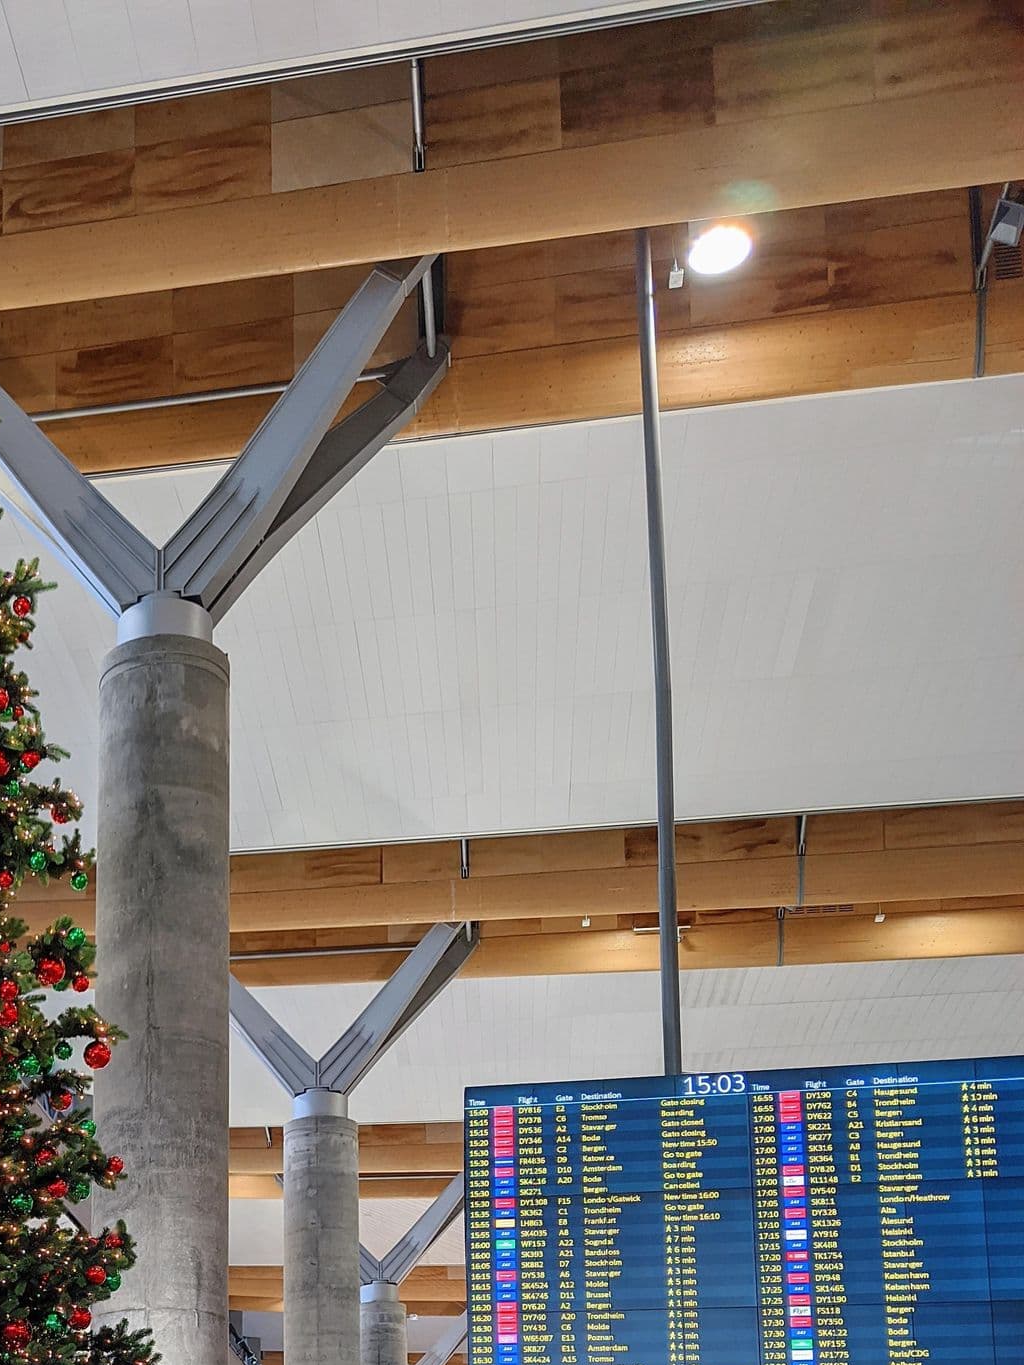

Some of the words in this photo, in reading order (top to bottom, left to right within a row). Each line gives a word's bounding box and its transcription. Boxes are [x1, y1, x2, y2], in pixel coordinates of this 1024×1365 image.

[684, 1074, 745, 1095] 15:03
[752, 1083, 770, 1091] Time
[805, 1080, 827, 1090] Flight
[873, 1075, 918, 1085] Destination
[469, 1099, 486, 1107] Time
[556, 1094, 573, 1102] Gate
[581, 1091, 622, 1101] Destination
[753, 1094, 774, 1102] 16:55
[874, 1087, 918, 1097] Haugesund
[875, 1097, 916, 1107] Trondheim
[469, 1108, 489, 1117] 15:00
[581, 1102, 618, 1111] Stockholm
[661, 1099, 680, 1107] Gate
[680, 1098, 705, 1107] closing
[661, 1109, 694, 1119] Boarding
[754, 1115, 775, 1123] 17:00
[875, 1109, 903, 1118] Bergen
[470, 1129, 489, 1137] 15:15
[582, 1122, 617, 1133] Stavanger
[661, 1119, 680, 1128] Gate
[681, 1118, 705, 1127] closed
[755, 1125, 776, 1133] 17:00
[876, 1118, 923, 1128] Kristiansand
[662, 1129, 681, 1138] Gate
[681, 1128, 707, 1138] closing
[755, 1136, 776, 1144] 17:00
[876, 1131, 904, 1140] Bergen
[582, 1144, 607, 1153] Bergen
[662, 1141, 680, 1149] New
[680, 1140, 696, 1148] time
[697, 1138, 718, 1147] 15:50
[877, 1140, 921, 1150] Haugesund
[663, 1151, 675, 1159] Go
[675, 1150, 685, 1158] to
[685, 1149, 703, 1159] gate
[756, 1157, 777, 1165] 17:00
[878, 1151, 919, 1160] Trondheim
[583, 1164, 623, 1173] Amsterdam
[663, 1161, 697, 1170] Boarding
[878, 1162, 919, 1171] Stockholm
[470, 1180, 490, 1188] 15:30
[664, 1171, 676, 1179] Go
[676, 1171, 686, 1179] to
[686, 1170, 704, 1180] gate
[757, 1178, 778, 1186] 17:00
[879, 1172, 923, 1181] Amsterdam
[584, 1186, 609, 1195] Bergen
[664, 1181, 700, 1190] Cancelled
[757, 1189, 778, 1197] 17:05
[879, 1183, 918, 1193] Stavanger
[664, 1192, 682, 1201] New
[682, 1192, 698, 1200] time
[699, 1191, 720, 1199] 16:00
[880, 1193, 950, 1203] London/Heathrow
[585, 1206, 622, 1215] Trondheim
[677, 1203, 687, 1211] to
[687, 1202, 706, 1212] gate
[471, 1220, 491, 1229] 15:55
[665, 1214, 682, 1222] New
[682, 1213, 699, 1221] time
[700, 1213, 721, 1221] 16:10
[584, 1227, 620, 1237] Stavanger
[882, 1227, 913, 1236] Helsinki
[585, 1238, 614, 1247] Sogndal
[882, 1238, 924, 1247] Stockholm
[883, 1249, 915, 1258] Istanbul
[585, 1258, 623, 1267] Stockholm
[884, 1260, 923, 1270] Stavanger
[585, 1269, 621, 1279] Stavanger
[885, 1271, 930, 1280] København
[586, 1280, 609, 1289] Molde
[885, 1282, 930, 1291] København
[586, 1302, 612, 1311] Bergen
[887, 1305, 915, 1315] Bergen
[889, 1340, 917, 1348] Bergen
